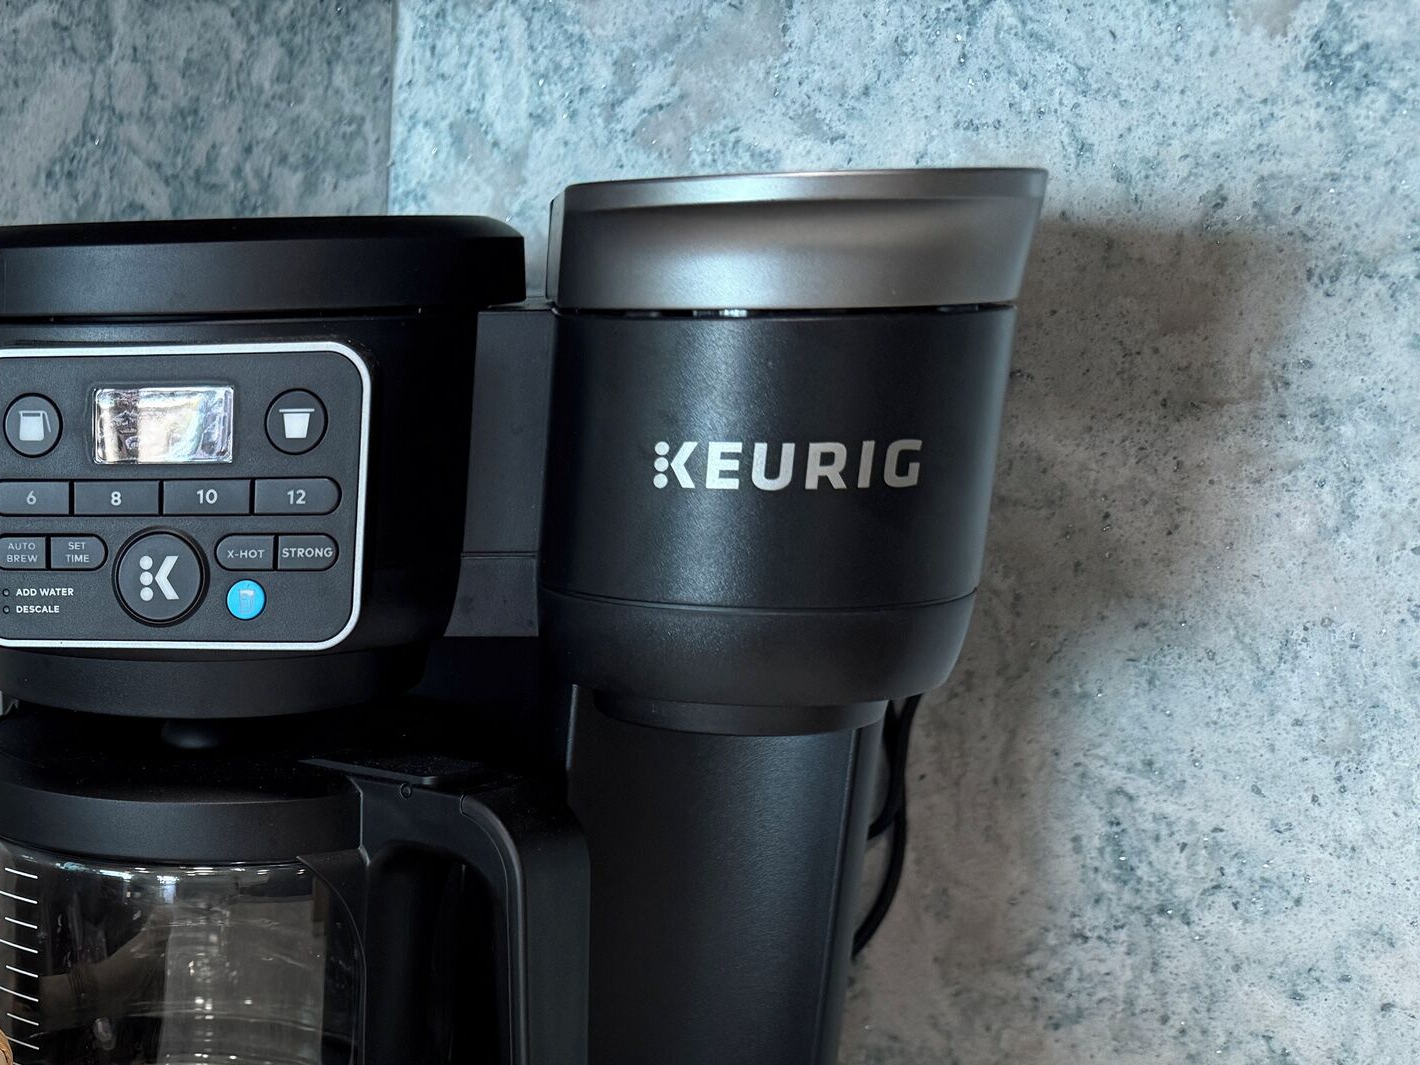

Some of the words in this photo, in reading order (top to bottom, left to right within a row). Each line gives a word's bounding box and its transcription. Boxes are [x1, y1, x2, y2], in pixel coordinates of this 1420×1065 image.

[653, 439, 923, 491] KEURIG
[26, 490, 37, 506] 6
[110, 491, 122, 506] 8
[196, 489, 218, 505] 10
[286, 489, 306, 505] 12
[8, 541, 36, 551] AUTO
[68, 541, 86, 551] SET
[227, 548, 265, 560] X-HOT
[281, 546, 333, 559] STRONG
[6, 554, 38, 564] BREW
[66, 554, 90, 564] TIME
[15, 587, 37, 597] ADD
[39, 587, 74, 597] WATER
[16, 604, 60, 614] DESCALE
